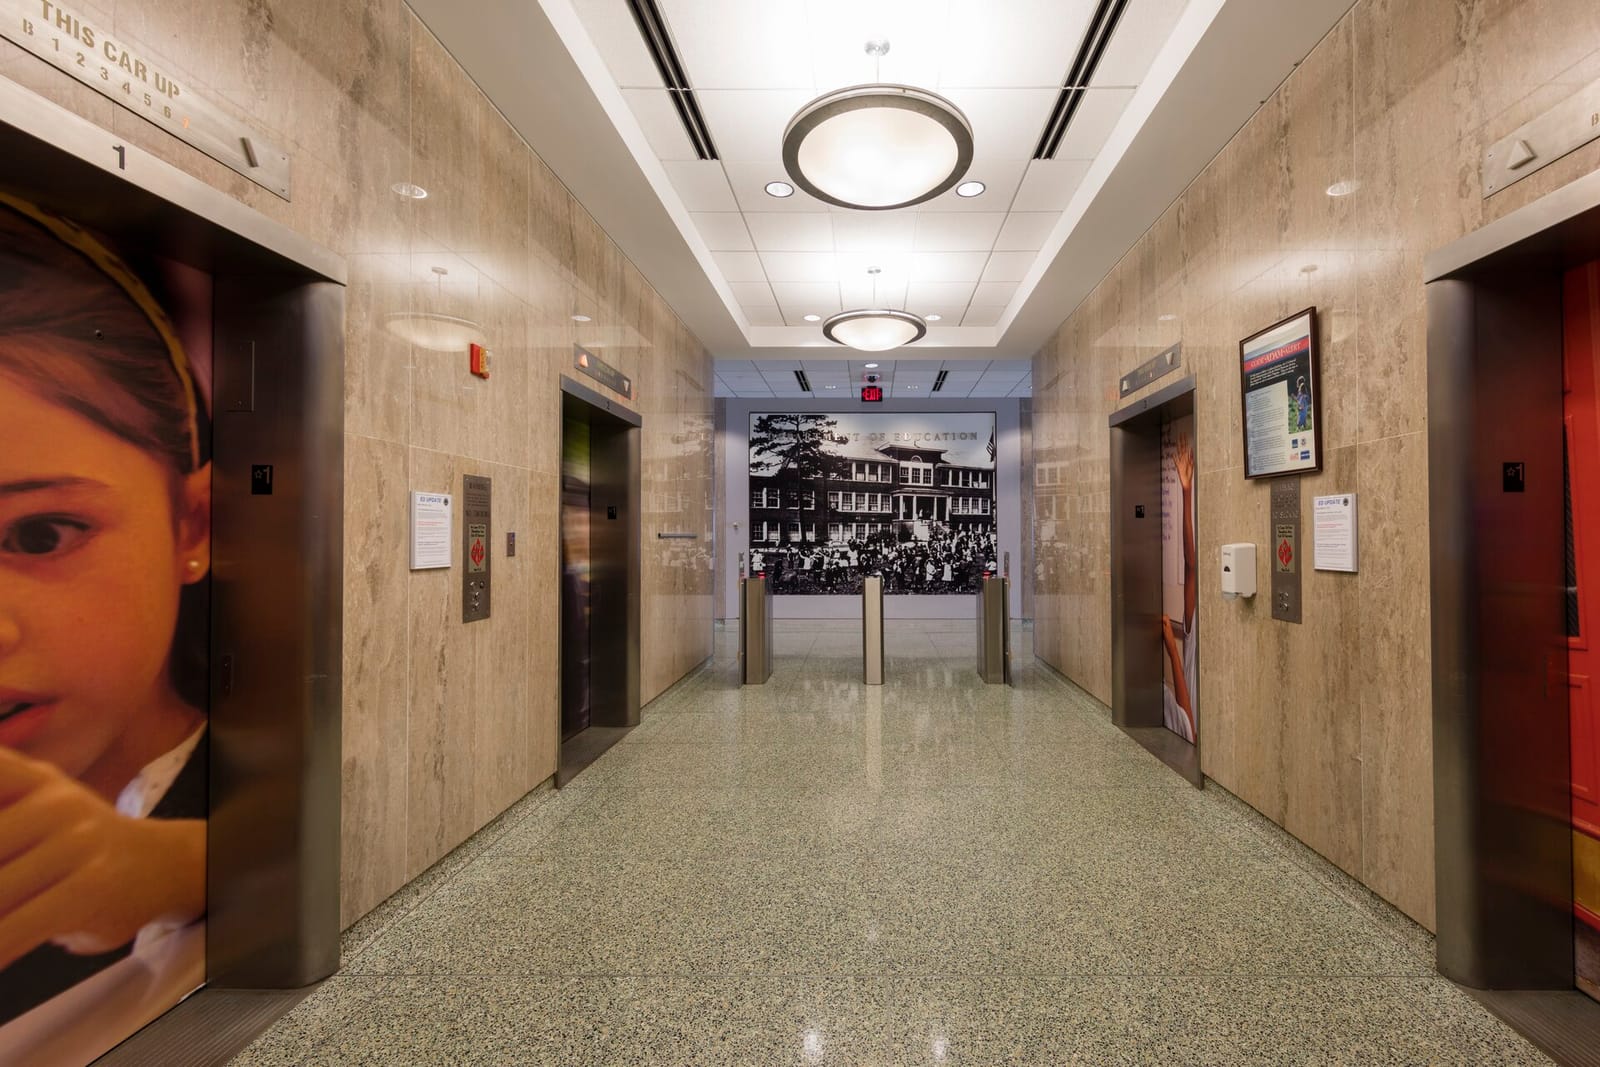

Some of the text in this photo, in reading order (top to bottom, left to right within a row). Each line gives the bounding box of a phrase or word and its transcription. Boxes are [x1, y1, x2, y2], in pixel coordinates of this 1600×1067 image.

[40, 0, 180, 99] THIS CAR UP
[23, 18, 34, 36] B
[52, 37, 60, 51] 1
[76, 52, 86, 67] 2
[100, 66, 109, 81] 3
[122, 82, 131, 95] 4
[143, 92, 152, 106] 5
[163, 105, 172, 119] 6
[112, 144, 126, 170] 1
[865, 388, 879, 401] EXIT
[870, 432, 886, 442] OF
[894, 431, 978, 442] EDUCATION
